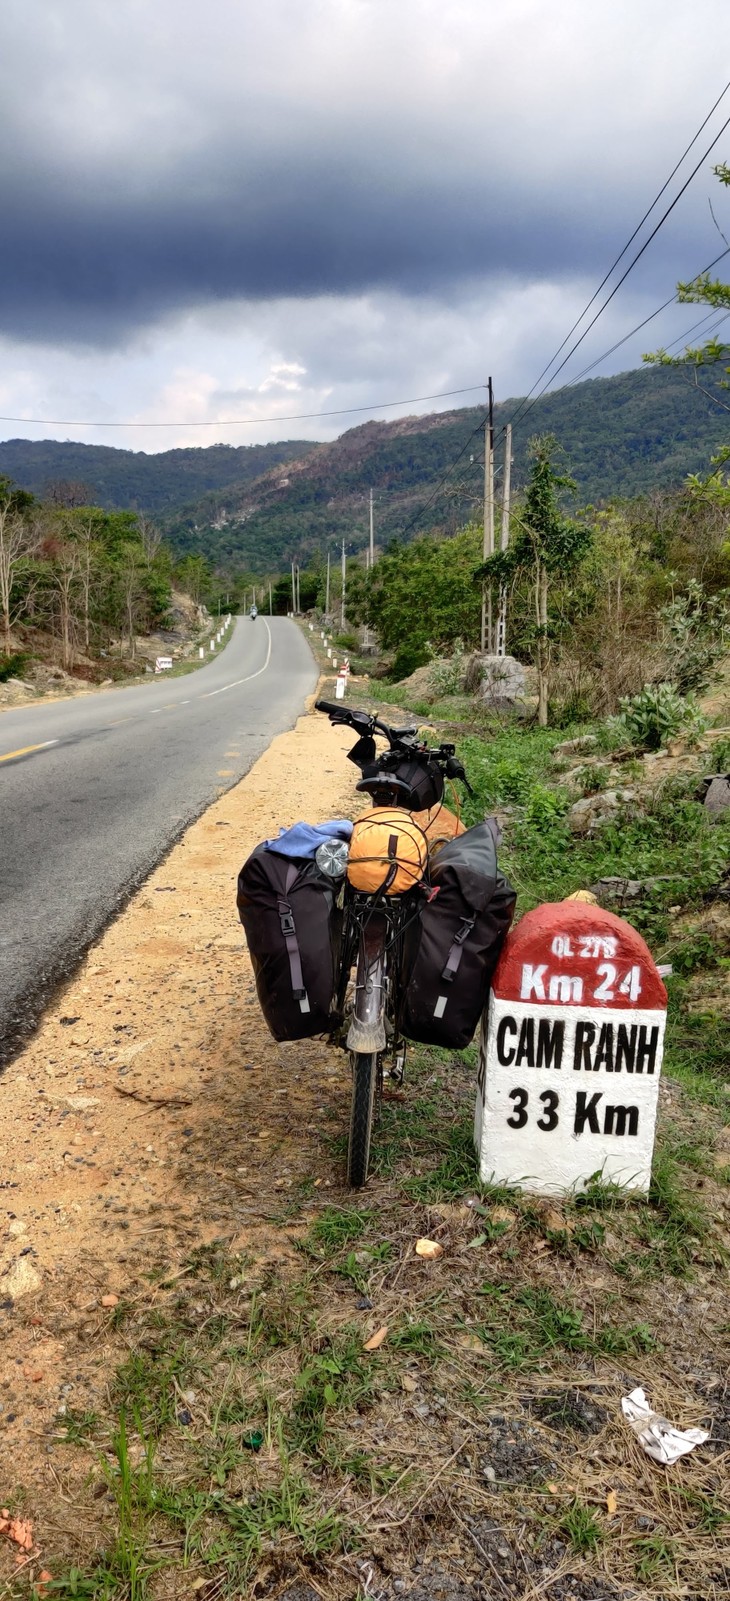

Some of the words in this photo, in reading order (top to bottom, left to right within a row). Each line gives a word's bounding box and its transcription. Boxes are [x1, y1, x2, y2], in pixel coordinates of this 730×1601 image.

[520, 963, 584, 1003] Km
[593, 963, 642, 1002] 24
[496, 1016, 566, 1070] CAM
[572, 1021, 660, 1075] RANH
[573, 1091, 640, 1137] Km
